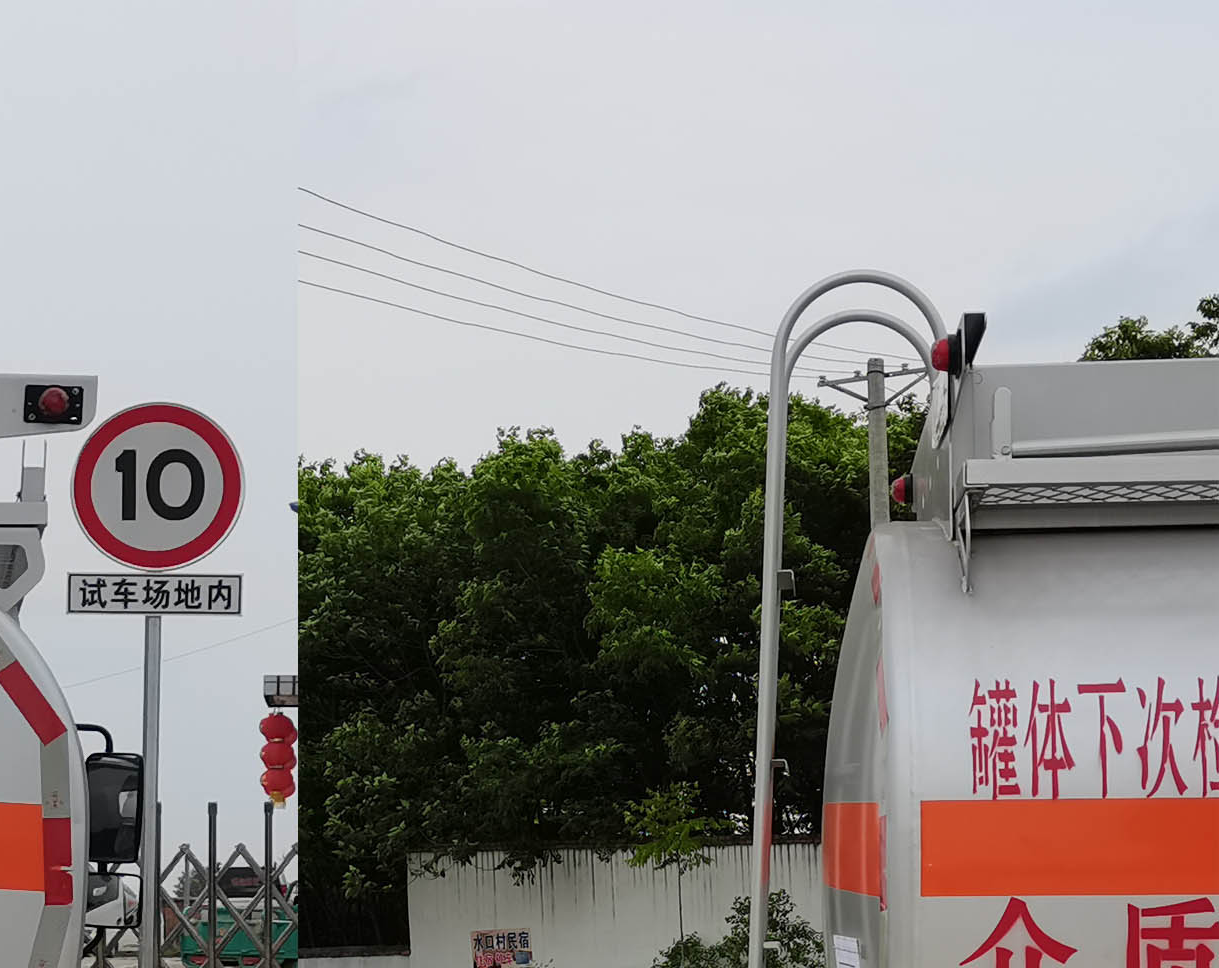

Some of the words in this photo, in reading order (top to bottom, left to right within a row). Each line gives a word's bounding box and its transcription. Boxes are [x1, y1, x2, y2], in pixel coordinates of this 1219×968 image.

[115, 448, 205, 521] 10
[79, 578, 232, 610] 试车场地内
